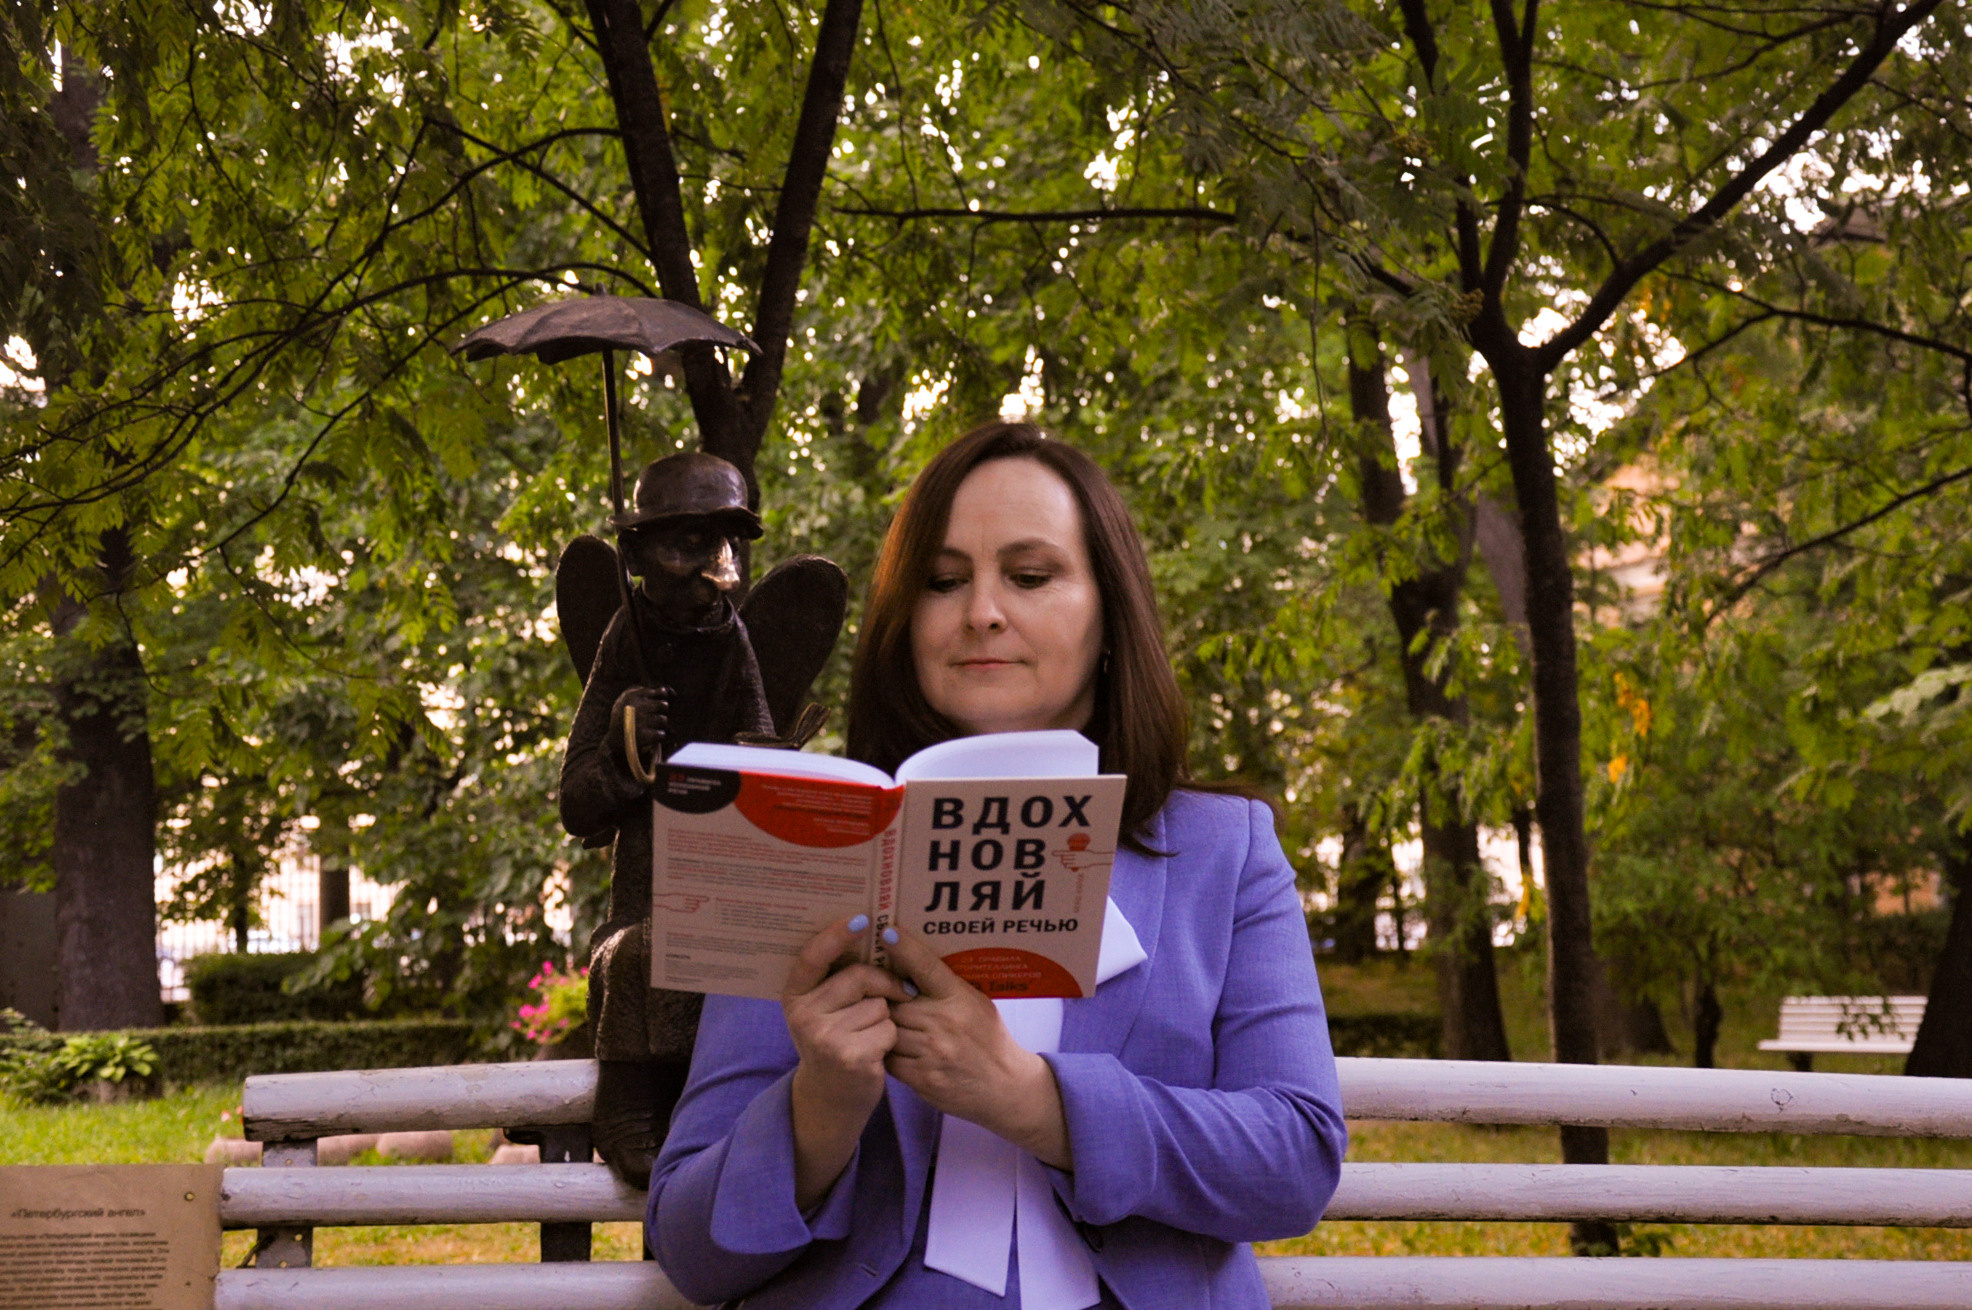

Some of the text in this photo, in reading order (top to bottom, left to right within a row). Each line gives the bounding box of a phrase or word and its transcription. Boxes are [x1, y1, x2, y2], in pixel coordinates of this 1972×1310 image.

[931, 795, 1093, 835] ВДОХ
[928, 838, 1046, 872] НОВ
[924, 871, 1046, 912] ЛЯЙ
[923, 917, 1078, 935] СВОЕЙ РЕЧЬЮ
